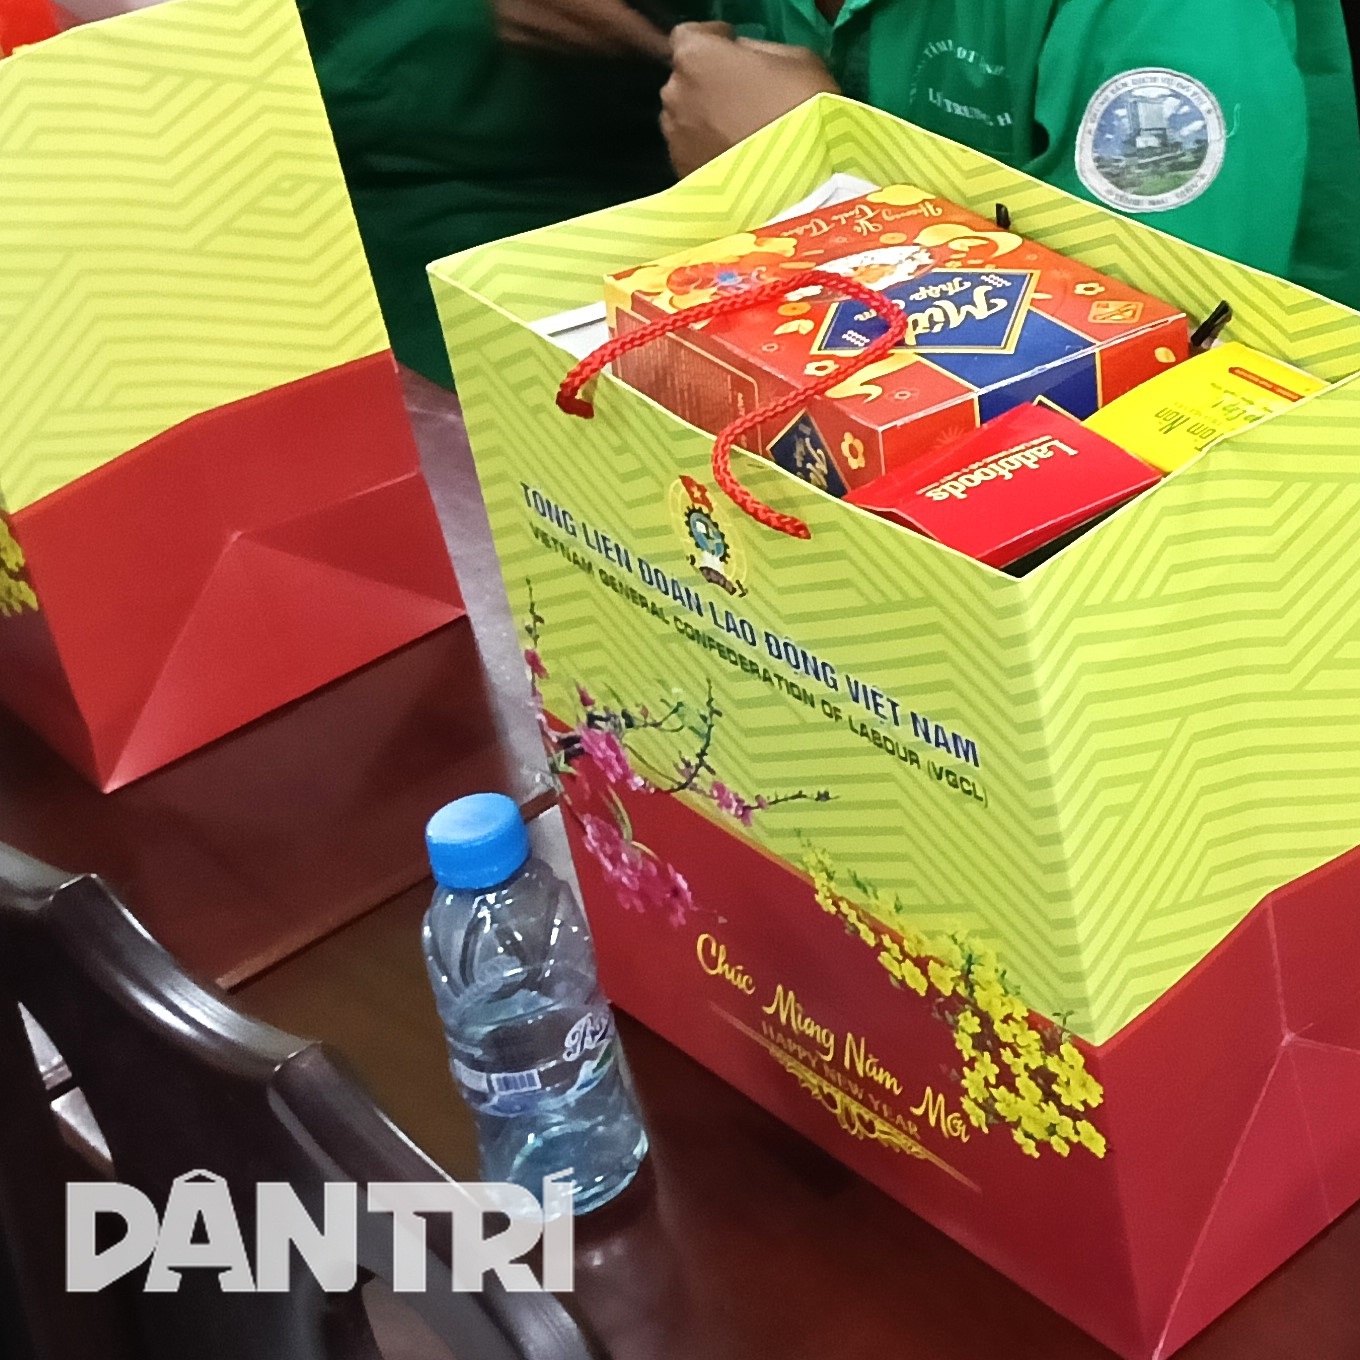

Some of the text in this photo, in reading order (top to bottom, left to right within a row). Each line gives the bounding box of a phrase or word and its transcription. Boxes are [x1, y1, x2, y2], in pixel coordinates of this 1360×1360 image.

[924, 437, 1078, 502] Ladofoods
[529, 521, 595, 576] VIETNAM
[598, 567, 671, 626] GENERAL
[673, 614, 816, 710] CONFEDERATION
[821, 697, 843, 723] OF
[848, 714, 922, 771] LABOUR
[926, 758, 989, 809] (VGCL)
[708, 601, 758, 648] LAO
[764, 629, 839, 693] ĐỘNG
[845, 673, 900, 728] VIỆT
[909, 710, 980, 769] NAM
[696, 933, 755, 995] Chúc
[762, 984, 834, 1062] Mừng
[844, 1032, 903, 1095] Năm
